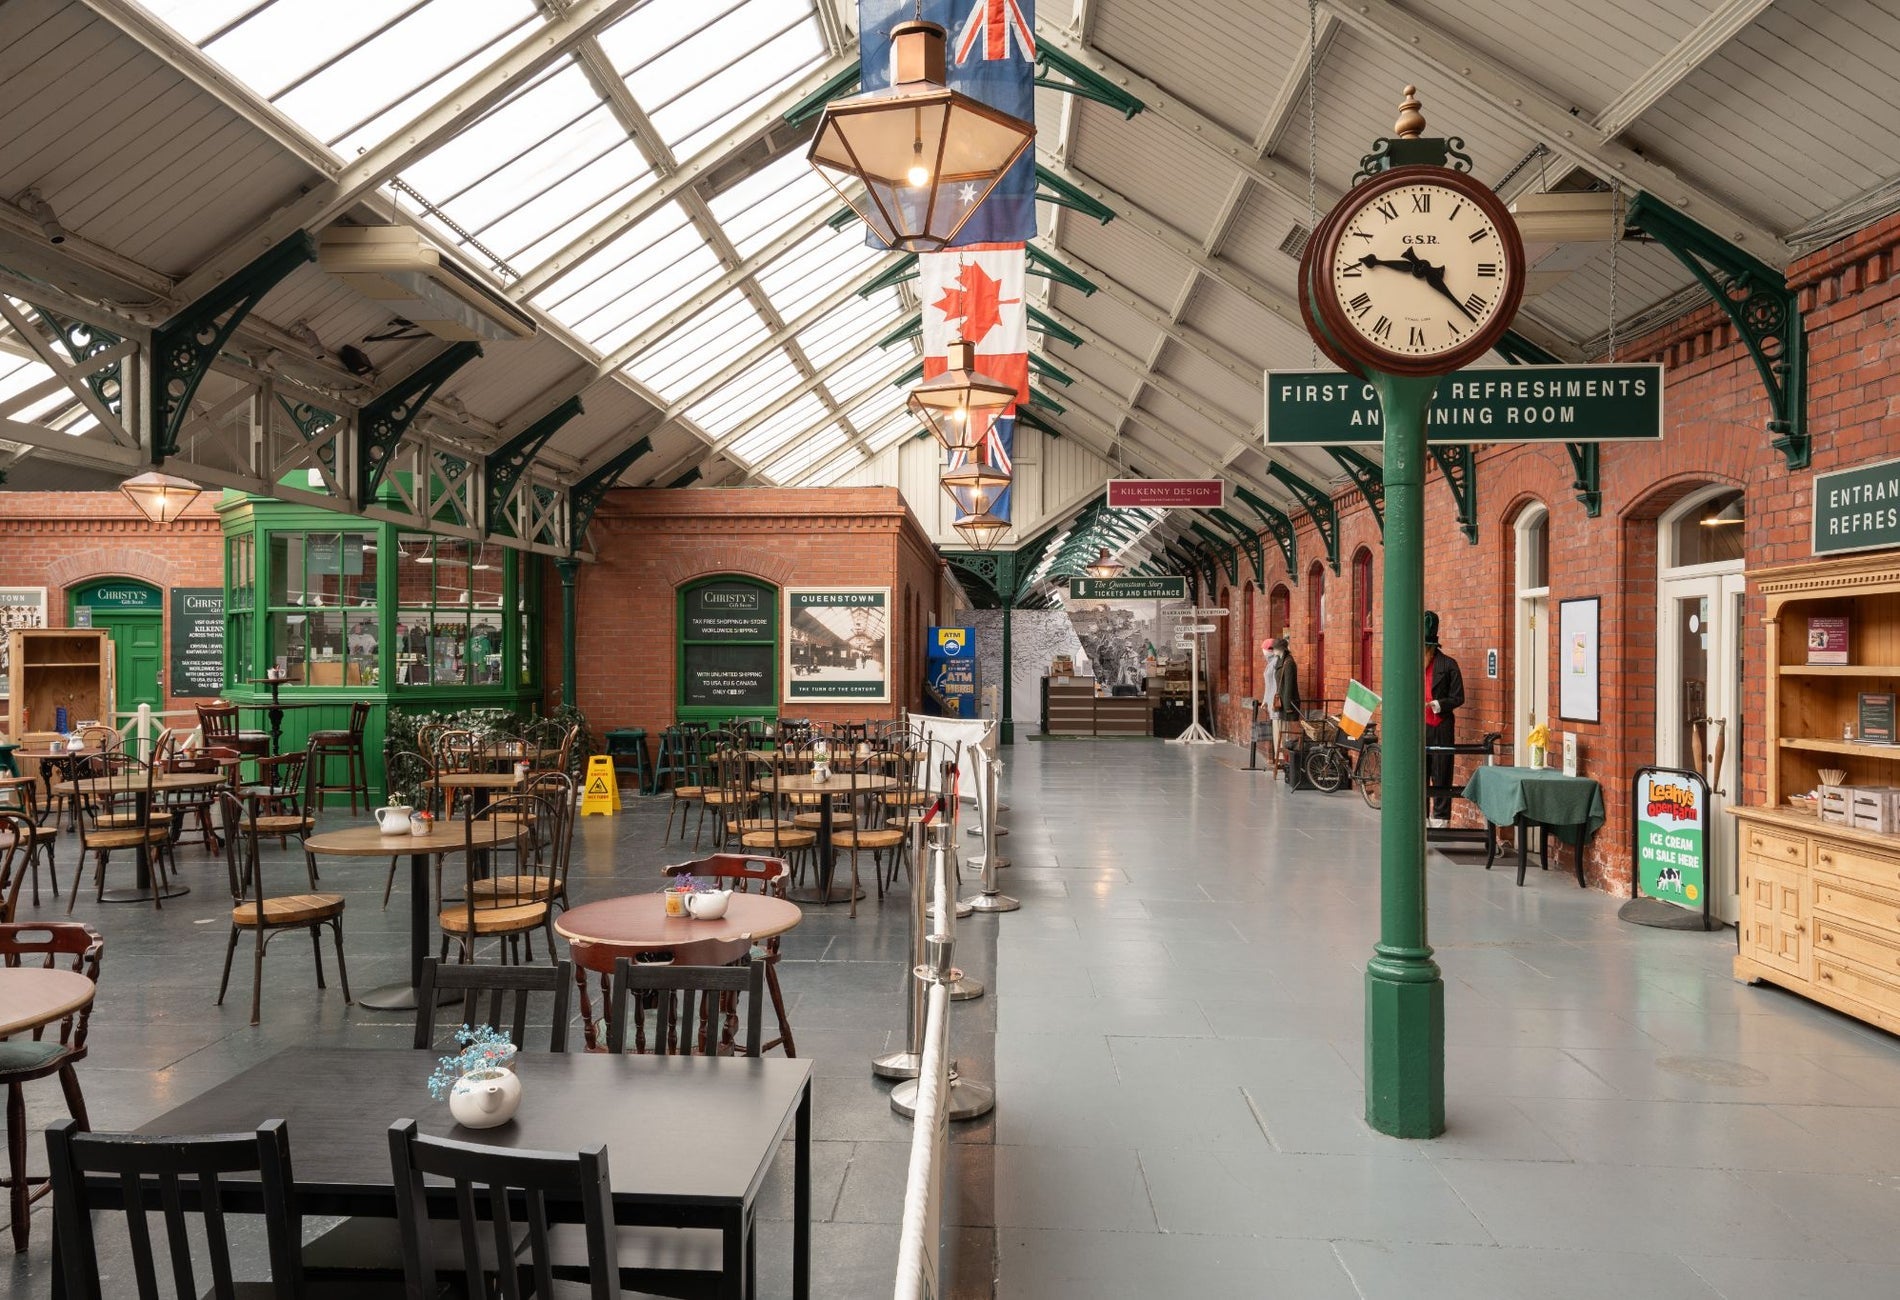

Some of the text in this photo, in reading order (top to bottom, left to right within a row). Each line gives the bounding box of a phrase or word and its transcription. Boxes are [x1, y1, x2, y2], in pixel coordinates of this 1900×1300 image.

[1402, 235, 1440, 245] G.S.R.
[1282, 385, 1349, 402] FIRST
[1452, 380, 1647, 399] REFRESHMENTS
[1351, 406, 1575, 426] AN INING ROOM
[1830, 479, 1899, 508] ENTRAN
[1830, 508, 1897, 535] REFRES
[98, 588, 148, 600] CHRISTY'S
[1094, 580, 1163, 590] The Queenstown Story
[1143, 589, 1180, 597] ENTRANCE
[704, 591, 756, 603] CHRISTY'S
[946, 671, 972, 682] ATM
[1649, 779, 1695, 807] Leahy's
[1650, 832, 1694, 852] ICE CREAM
[1642, 846, 1699, 868] ON SALE HERE
